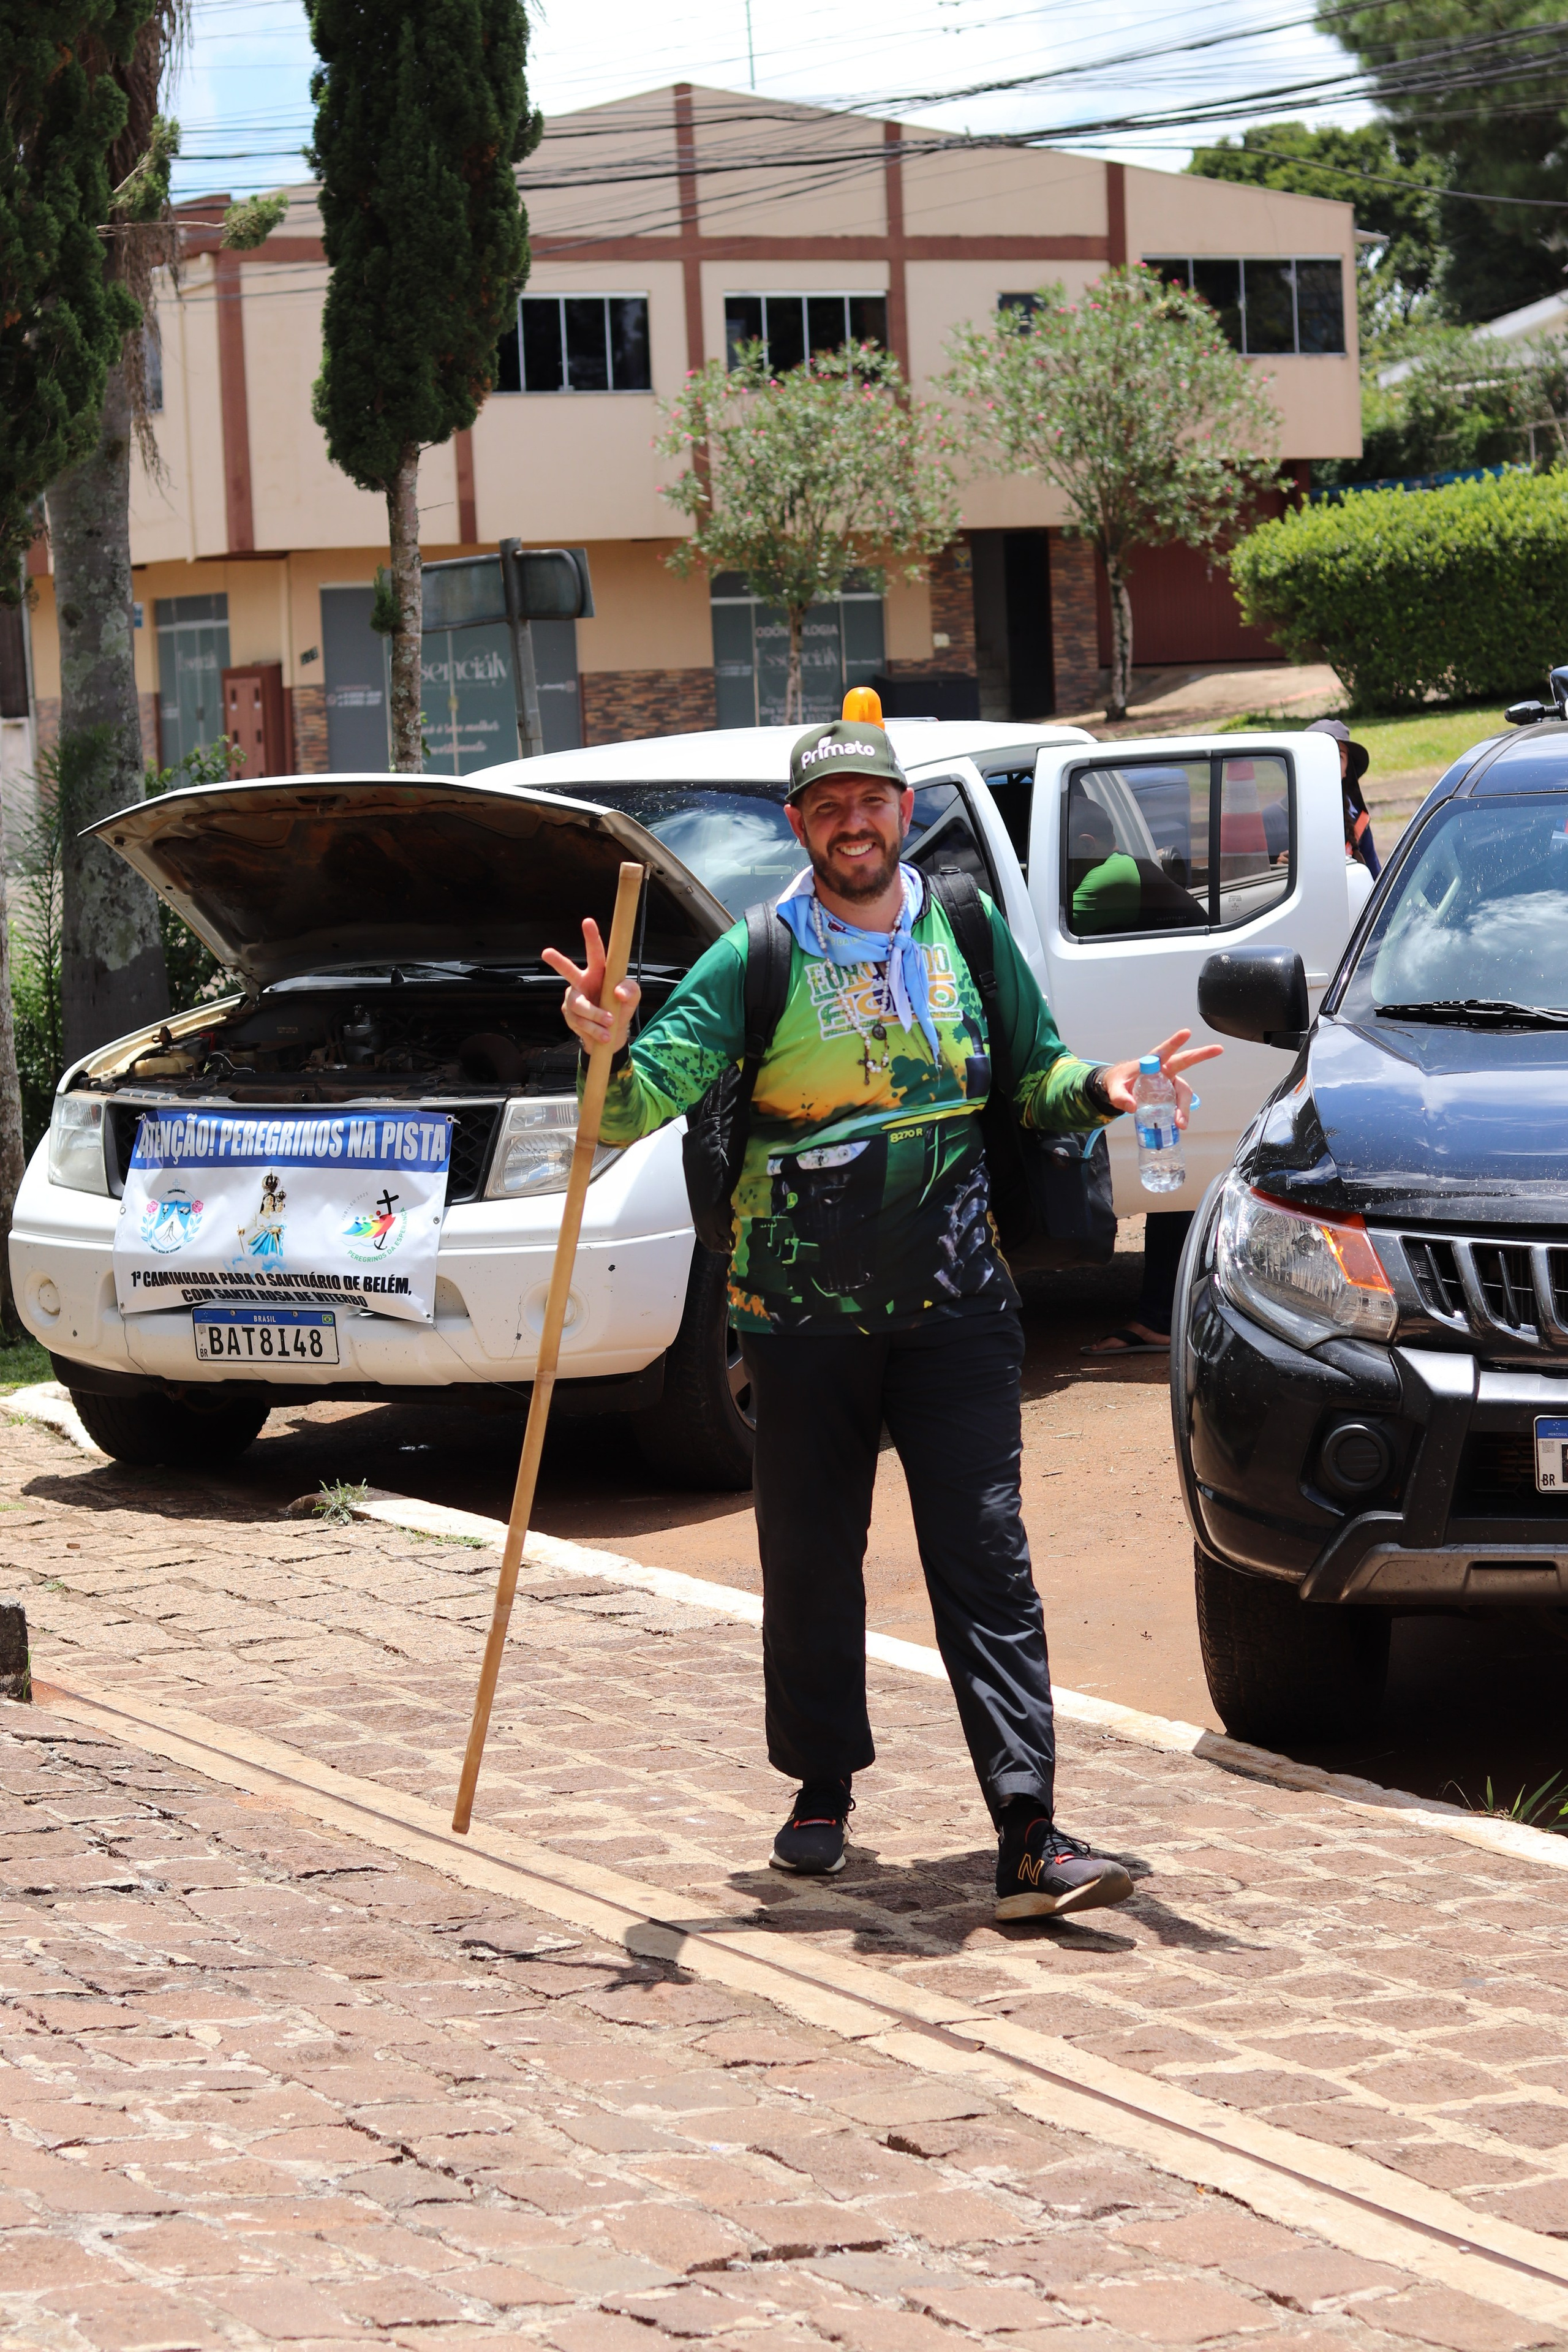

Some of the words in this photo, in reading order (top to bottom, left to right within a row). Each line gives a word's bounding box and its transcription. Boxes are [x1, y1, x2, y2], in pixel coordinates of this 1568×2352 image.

[755, 624, 839, 638] ODONLOGIA
[135, 1113, 218, 1165] ATENÇÃO!
[218, 1120, 344, 1158] PEREGRINOS
[347, 1120, 375, 1159] NA
[380, 1121, 446, 1161] PISTA
[890, 1129, 915, 1144] 8270
[916, 1127, 923, 1137] R
[347, 1250, 386, 1263] PEREGRINOS
[386, 1246, 396, 1255] DA
[394, 1207, 409, 1246] ESPERANÇA
[131, 1271, 141, 1287] 1ª
[143, 1271, 220, 1287] CAMINHADA
[221, 1272, 256, 1286] PARA
[254, 1273, 266, 1286] O
[266, 1272, 342, 1290] SANTUÁRIO
[343, 1275, 361, 1291] DE
[363, 1274, 412, 1295] BELÉM,
[181, 1288, 215, 1302] COM
[214, 1289, 257, 1300] SANTA
[256, 1290, 296, 1302] ROSA
[294, 1292, 314, 1302] DE
[311, 1292, 368, 1308] VITERBO
[208, 1327, 323, 1357] BAT8I48
[200, 1348, 208, 1358] BR
[1542, 1474, 1556, 1487] BR
